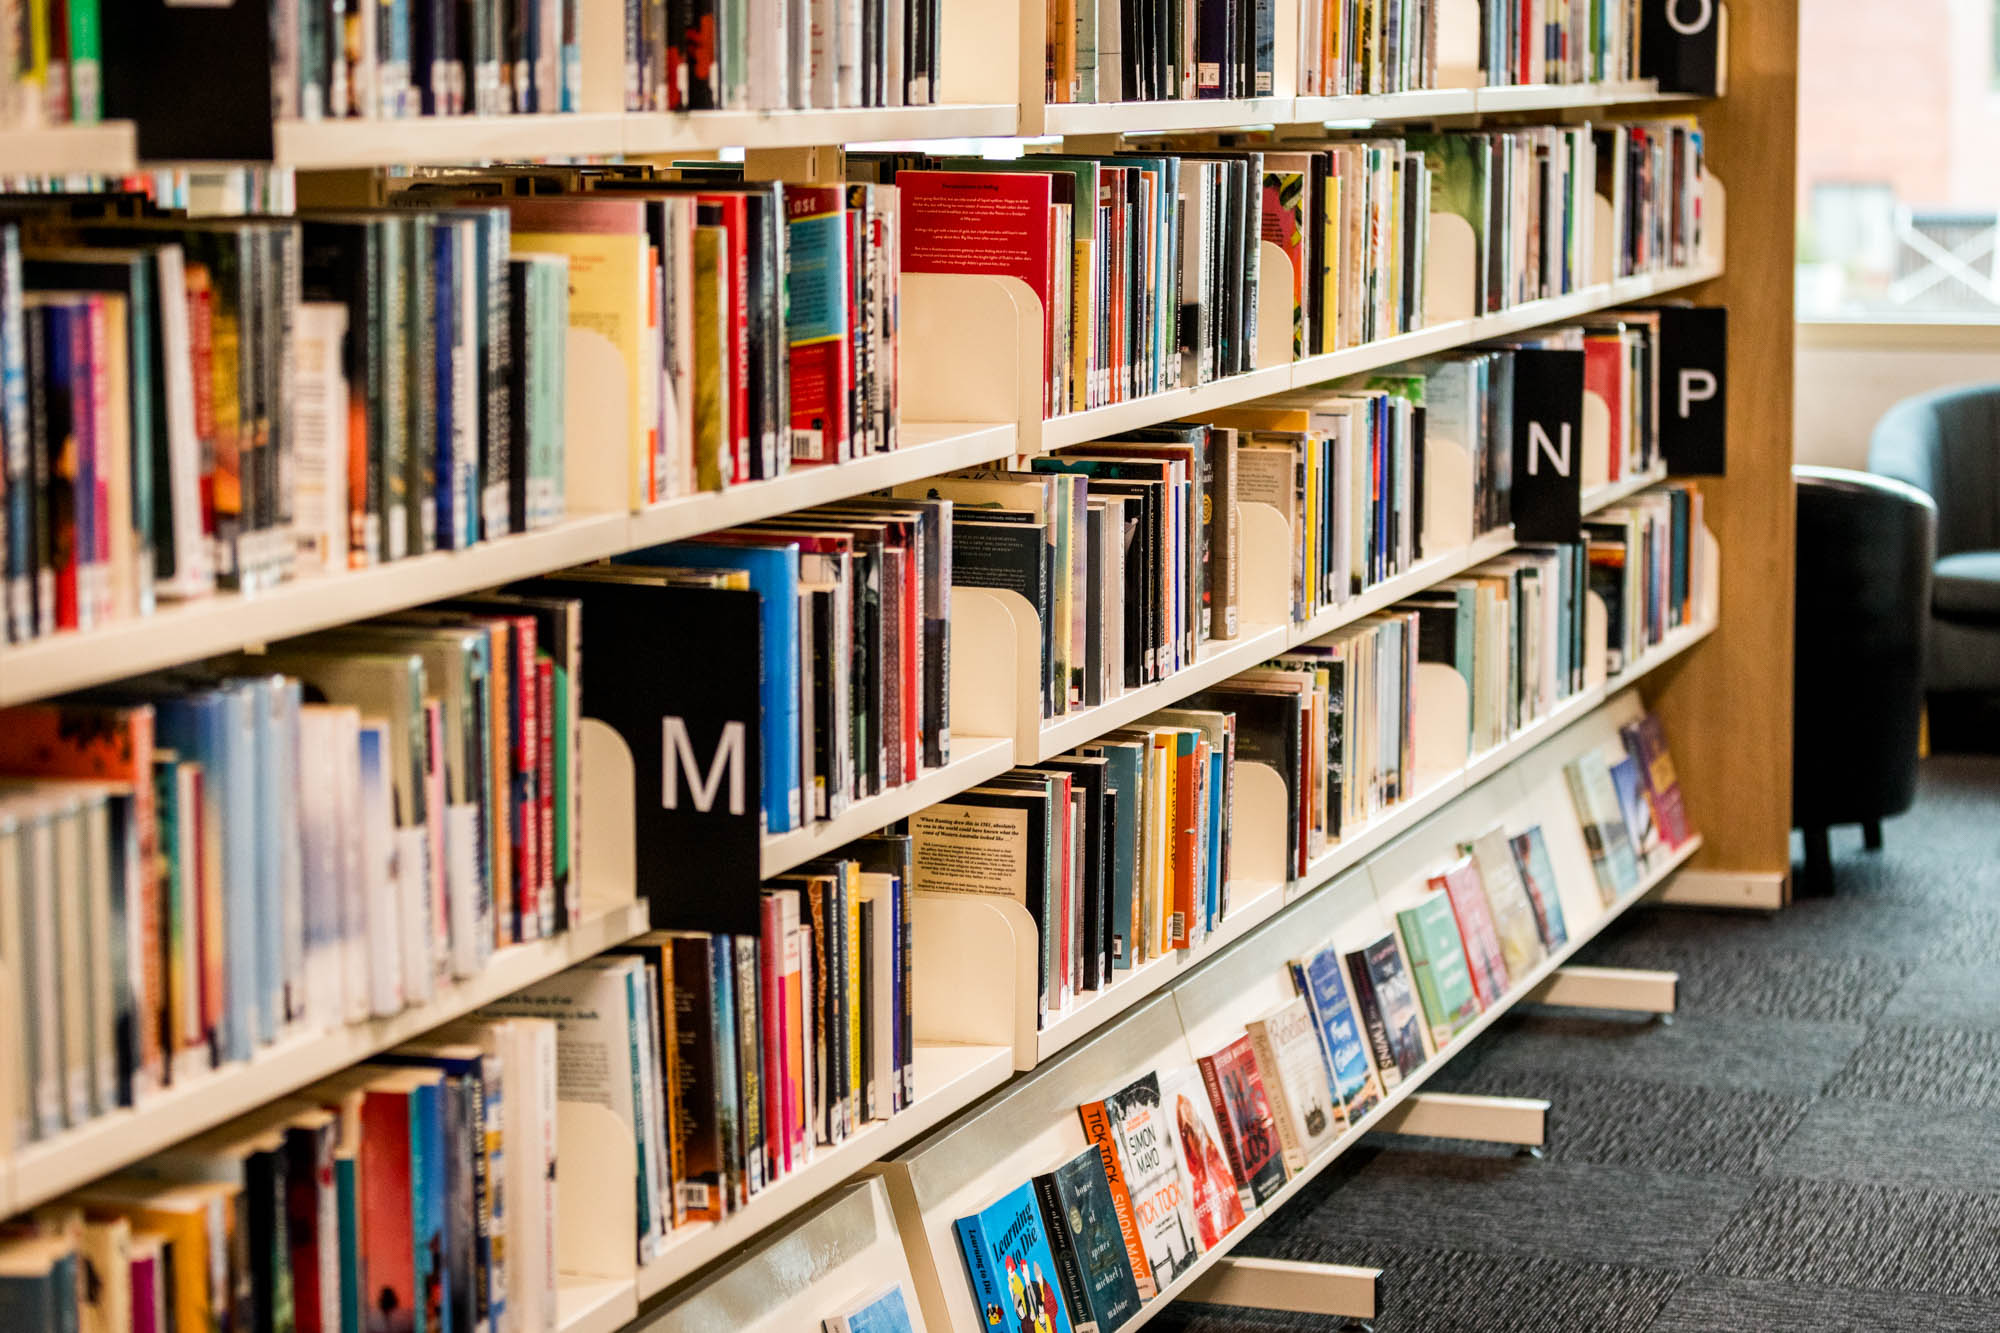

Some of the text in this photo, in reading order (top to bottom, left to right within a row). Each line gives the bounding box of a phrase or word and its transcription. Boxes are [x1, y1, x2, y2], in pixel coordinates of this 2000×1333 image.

[1666, 0, 1712, 35] O
[1678, 368, 1718, 419] P
[1528, 421, 1572, 477] N
[661, 715, 745, 816] M
[1370, 1020, 1394, 1069] TWINS
[1129, 1124, 1157, 1156] SIMON
[1136, 1147, 1160, 1176] MAYO
[1075, 1181, 1093, 1197] house
[1087, 1110, 1145, 1281] TICK TOCK SIMON MAYO
[1135, 1196, 1160, 1231] TICK
[1155, 1181, 1184, 1215] TOCK
[993, 1201, 1034, 1264] Learning
[1044, 1184, 1054, 1208] house
[1053, 1222, 1066, 1249] spines
[1064, 1259, 1079, 1293] michael
[1088, 1211, 1096, 1224] of
[968, 1229, 984, 1269] Learning
[982, 1280, 993, 1295] Die
[1012, 1226, 1038, 1269] to Die
[1091, 1240, 1111, 1260] spines
[1095, 1266, 1119, 1292] michael
[1107, 1300, 1129, 1320] malone
